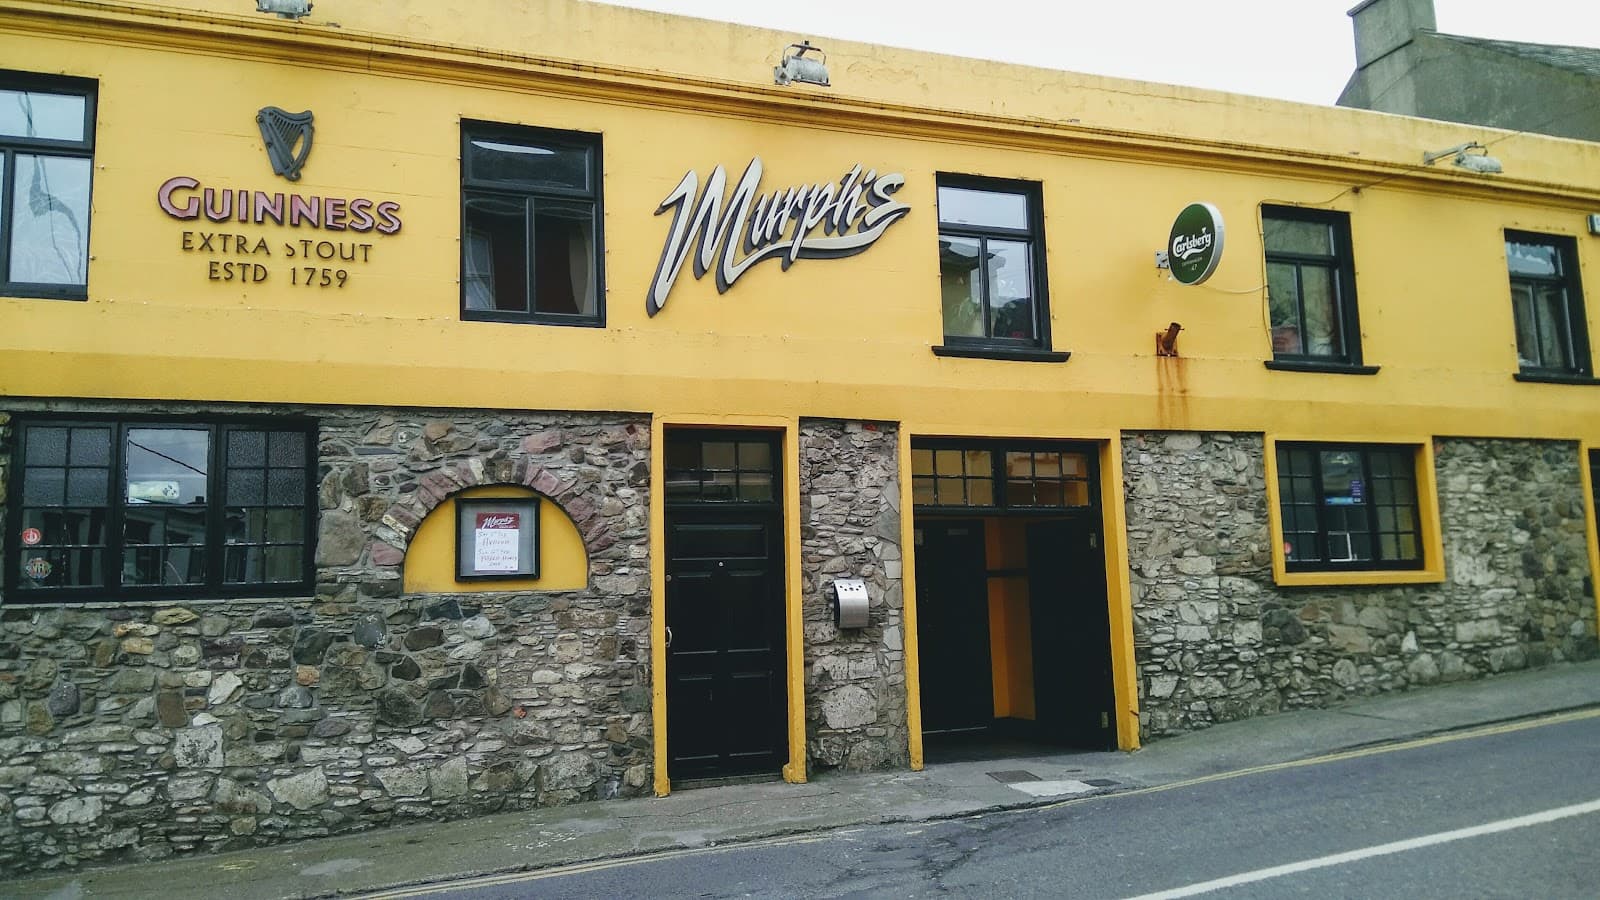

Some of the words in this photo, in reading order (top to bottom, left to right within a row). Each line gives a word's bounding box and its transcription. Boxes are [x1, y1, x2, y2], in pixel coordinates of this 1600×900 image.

[157, 176, 402, 235] GUINNESS
[181, 231, 271, 256] EXTRA
[285, 239, 373, 262] STOUT
[646, 156, 912, 318] Murph's
[1172, 226, 1212, 260] Carlsberg
[208, 261, 268, 283] ESTD
[290, 267, 348, 288] 1759
